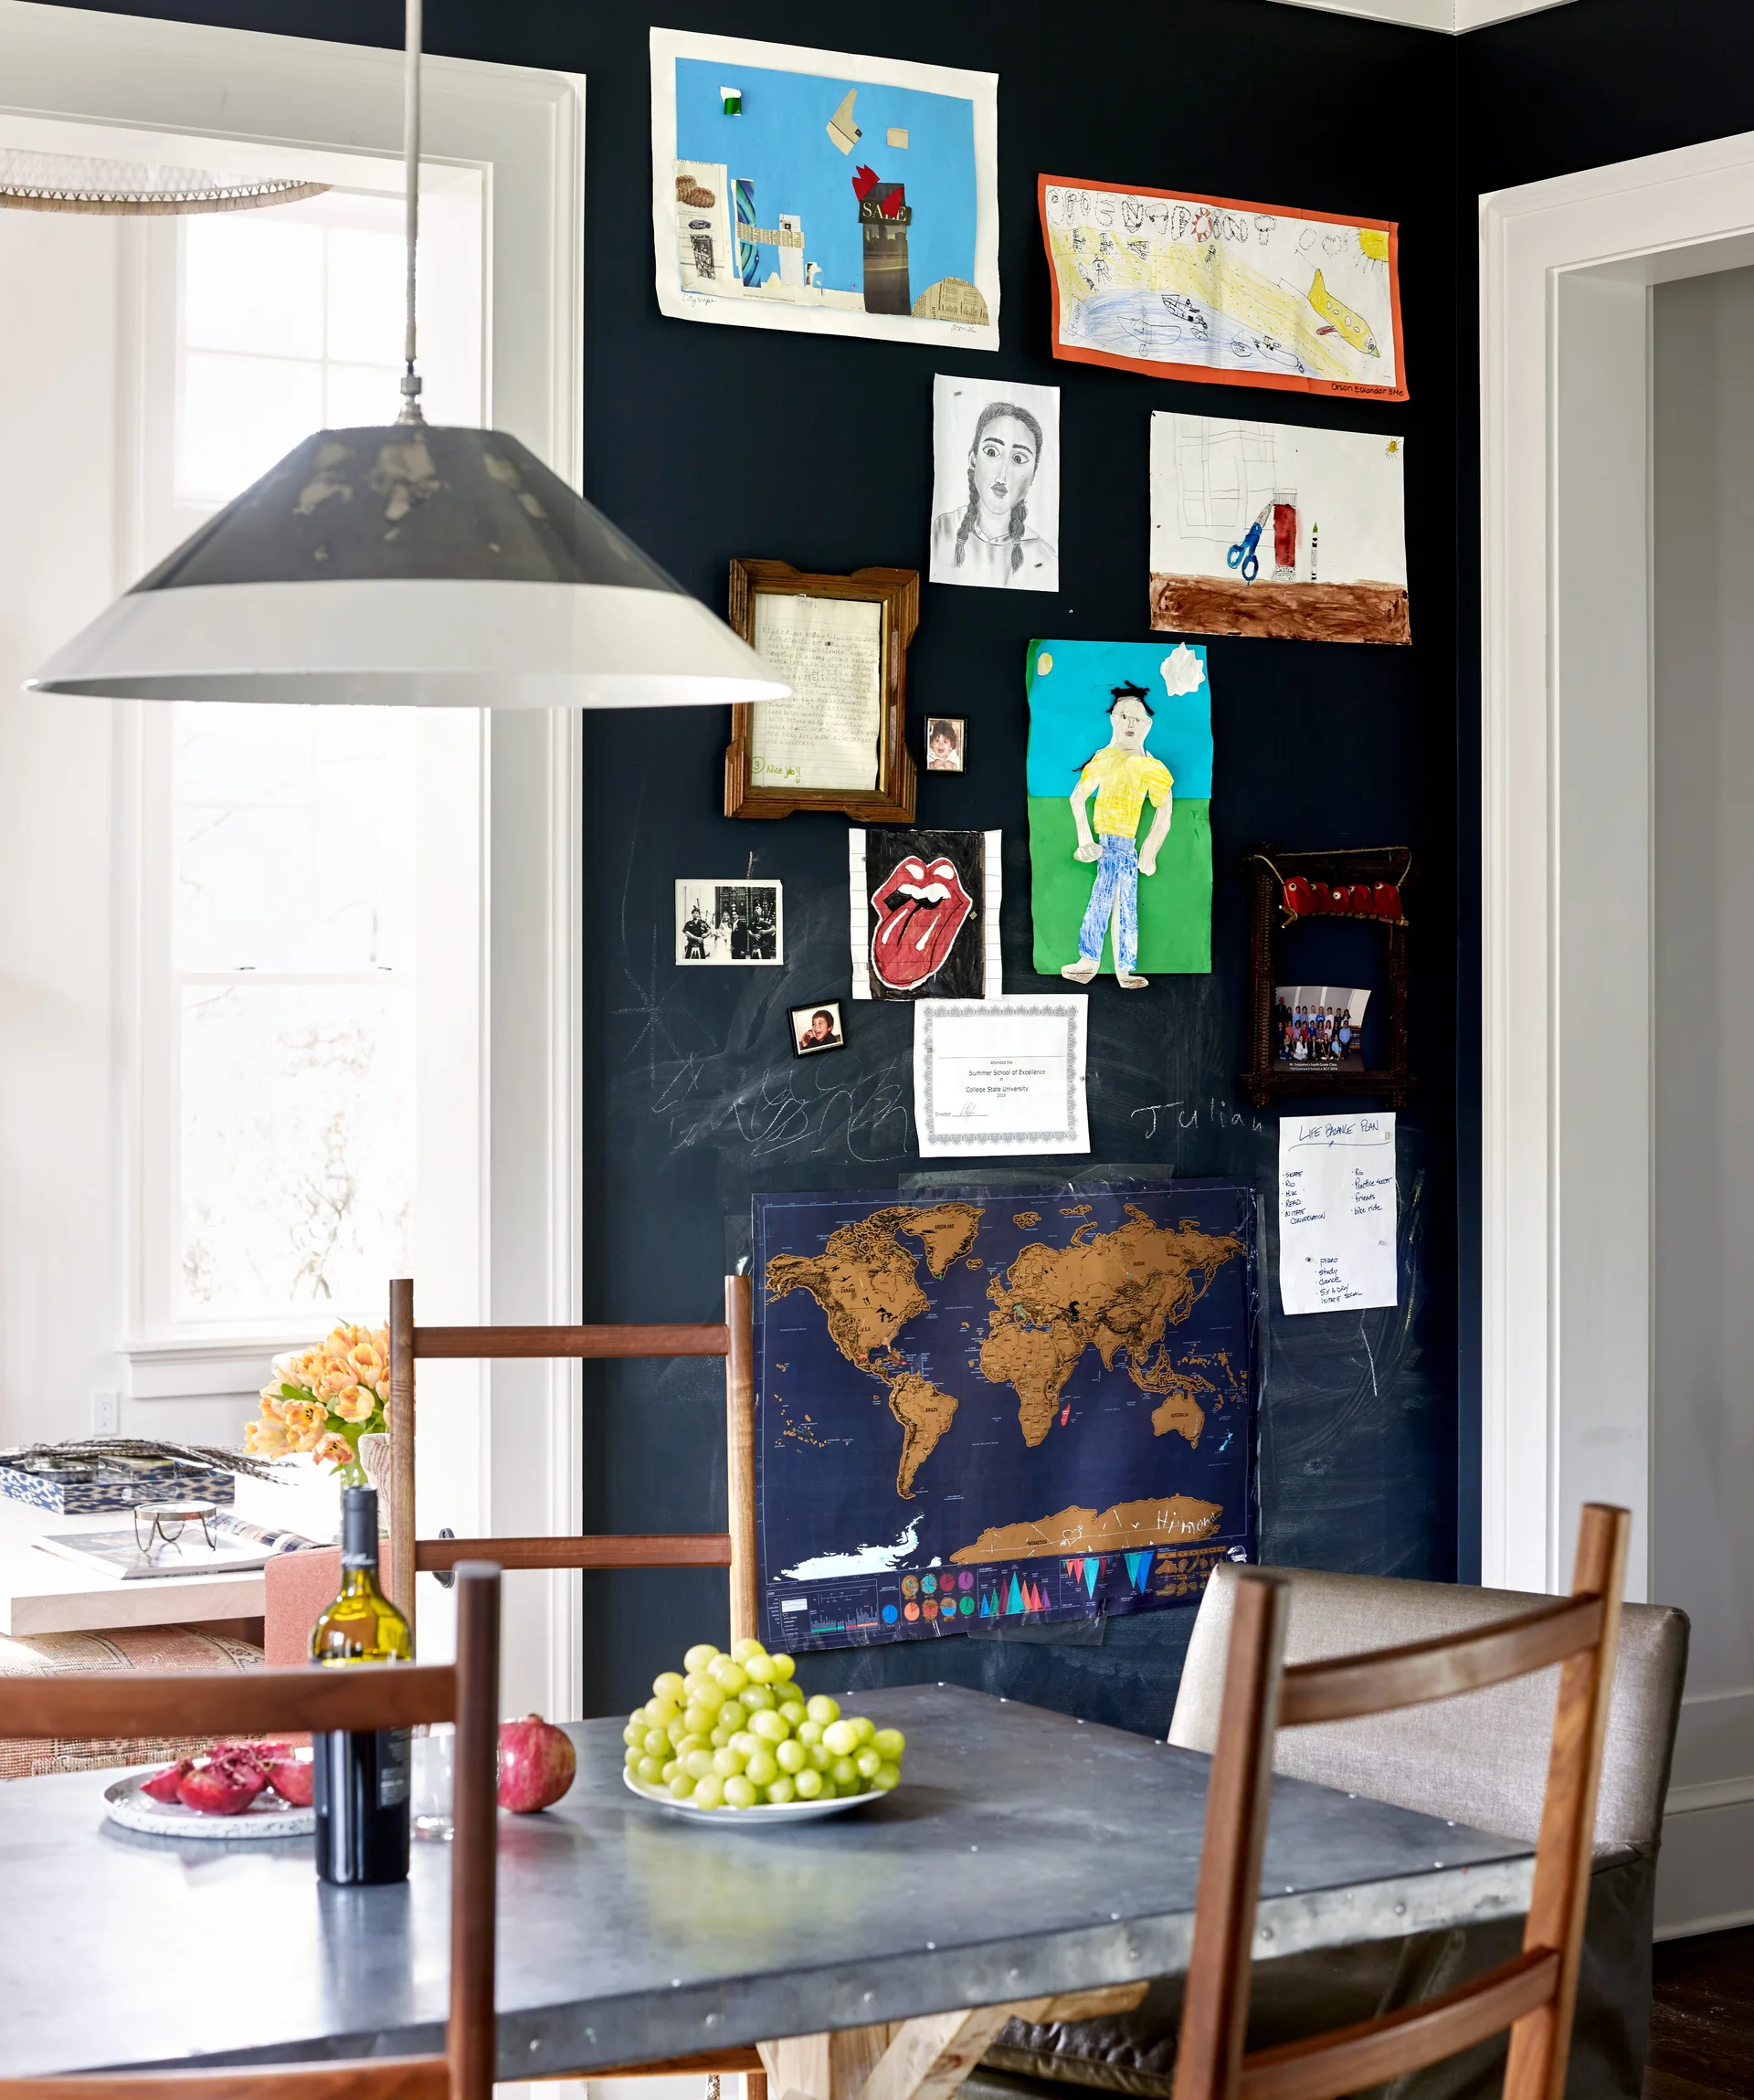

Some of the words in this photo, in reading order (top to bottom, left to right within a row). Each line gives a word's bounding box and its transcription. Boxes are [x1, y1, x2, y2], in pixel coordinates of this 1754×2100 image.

[862, 201, 907, 222] SAE
[692, 220, 707, 229] Ford
[1331, 383, 1353, 391] Orson
[1354, 385, 1388, 395] Eskandar
[766, 765, 784, 775] Nice
[1298, 1124, 1323, 1141] LIFE
[1360, 1119, 1379, 1132] PLAN
[1354, 1191, 1376, 1202] friends
[1354, 1205, 1366, 1216] bike
[1368, 1203, 1383, 1211] ride
[1318, 1267, 1338, 1278] study
